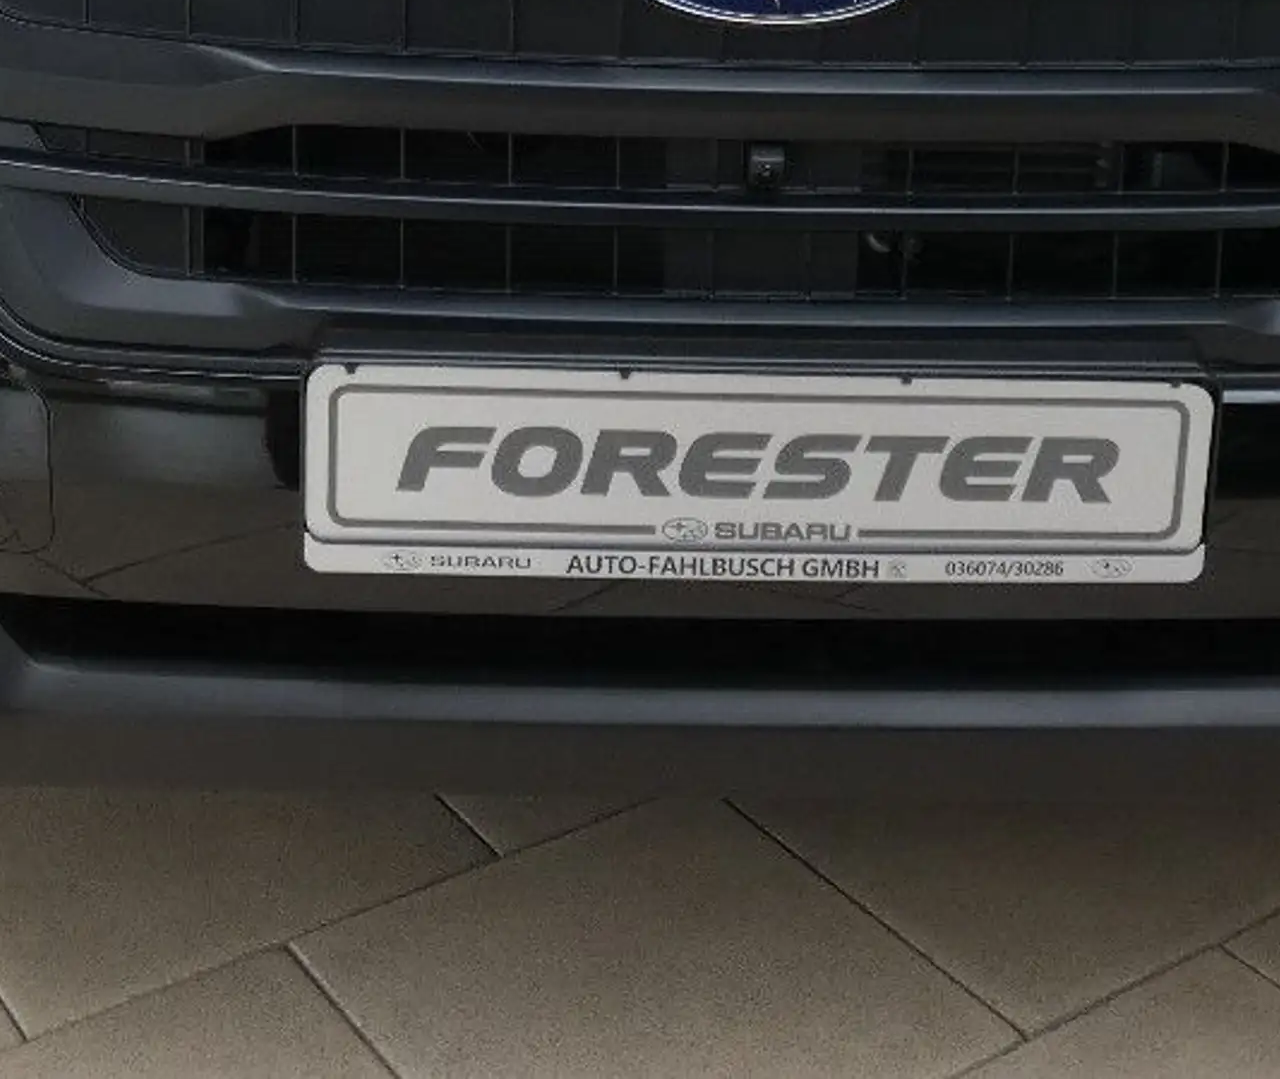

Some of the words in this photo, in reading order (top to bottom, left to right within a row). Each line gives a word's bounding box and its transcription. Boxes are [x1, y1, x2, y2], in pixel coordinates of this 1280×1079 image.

[395, 425, 1120, 504] FORESTER
[715, 522, 851, 541] SUBARU
[429, 554, 532, 570] SUBARU
[565, 555, 794, 577] AUTO-FAHLBUSCH
[802, 558, 880, 578] GMBH
[945, 560, 1064, 577] 036074/30286
